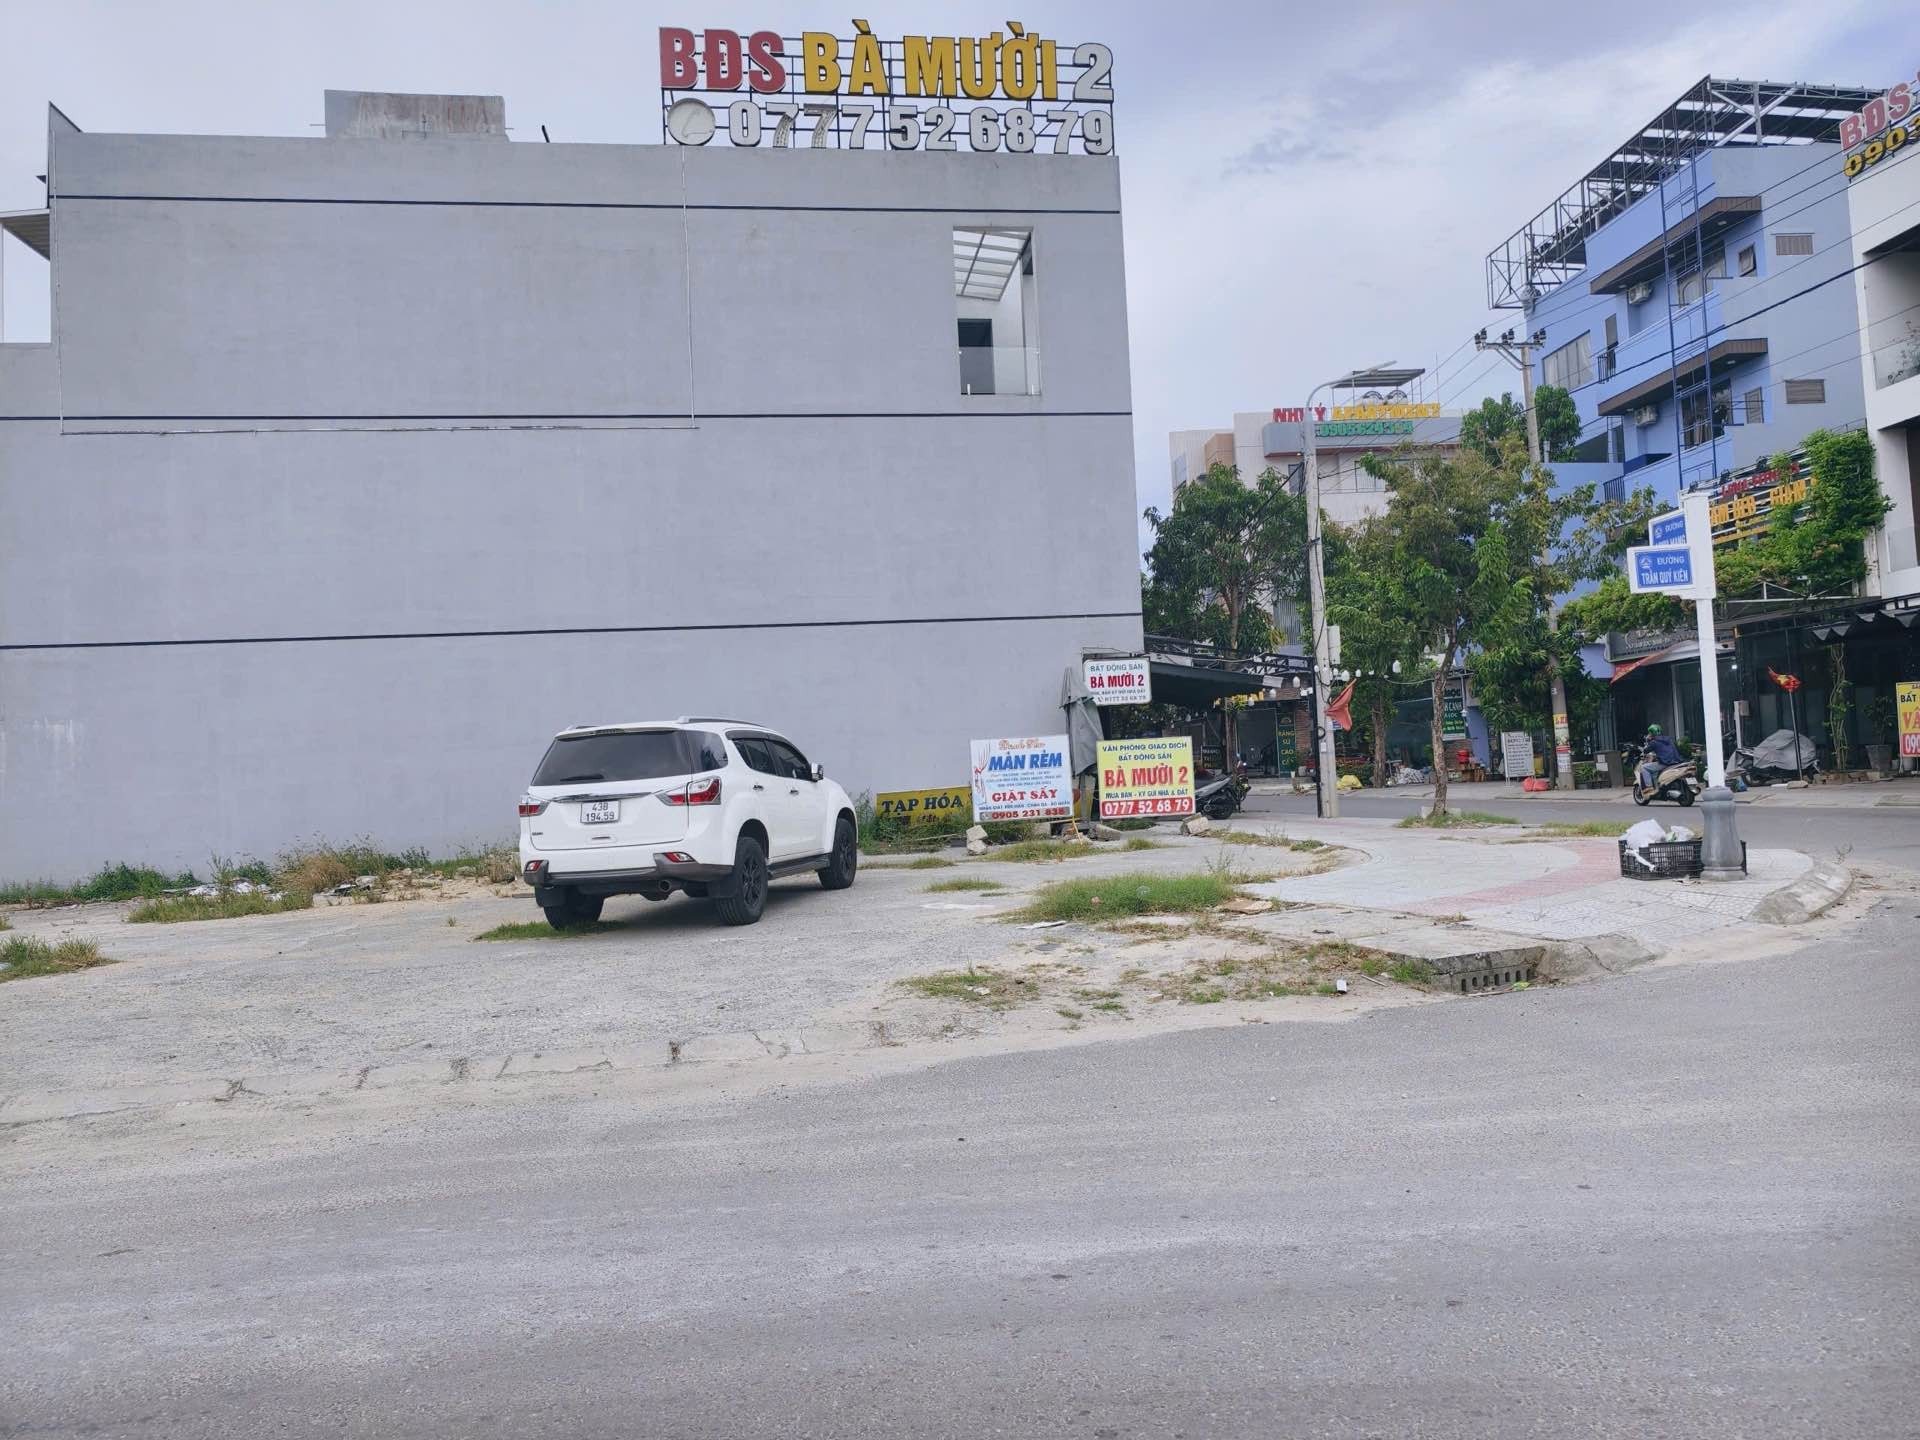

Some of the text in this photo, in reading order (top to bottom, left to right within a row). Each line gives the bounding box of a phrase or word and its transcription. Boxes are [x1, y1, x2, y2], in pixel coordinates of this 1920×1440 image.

[659, 18, 1115, 103] BĐS BÀ MƯỜI 2
[728, 100, 875, 150] 0777
[1090, 672, 1145, 689] BÀ MƯỜI 2
[1901, 691, 1917, 702] BẤT
[988, 749, 1063, 771] MÀN RÈM
[1104, 762, 1188, 788] BÀ MƯỜI 2
[881, 792, 964, 815] TẠP HÓA
[992, 785, 1059, 804] GIẶT SẤY
[991, 810, 1019, 820] 0905
[1022, 809, 1040, 818] 231
[1105, 798, 1190, 816] 0777 52 68 79
